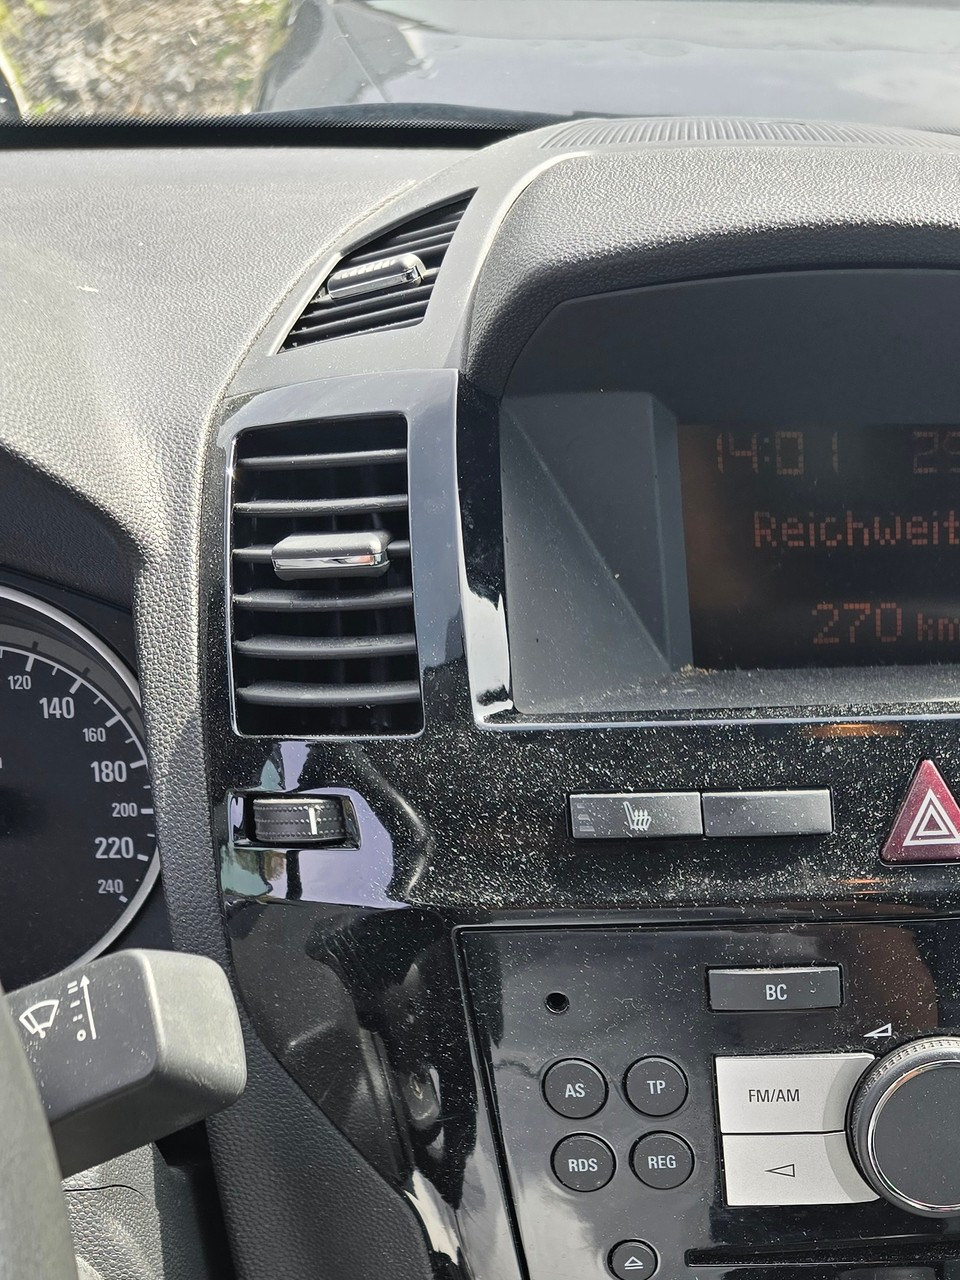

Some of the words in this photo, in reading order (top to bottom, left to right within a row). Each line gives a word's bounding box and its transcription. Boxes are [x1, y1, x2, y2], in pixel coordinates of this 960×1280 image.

[715, 431, 839, 474] 14:01
[811, 602, 903, 645] 270
[7, 674, 32, 690] 120
[39, 696, 75, 719] 140
[82, 727, 107, 743] 160
[90, 760, 128, 783] 180
[111, 802, 138, 818] 200
[94, 836, 135, 859] 220
[97, 878, 124, 895] 240
[764, 983, 788, 1002] BC
[564, 1082, 586, 1099] AS
[646, 1079, 666, 1096] TP
[748, 1089, 800, 1103] FM/AM
[567, 1157, 599, 1173] RDS
[647, 1154, 678, 1170] REG
